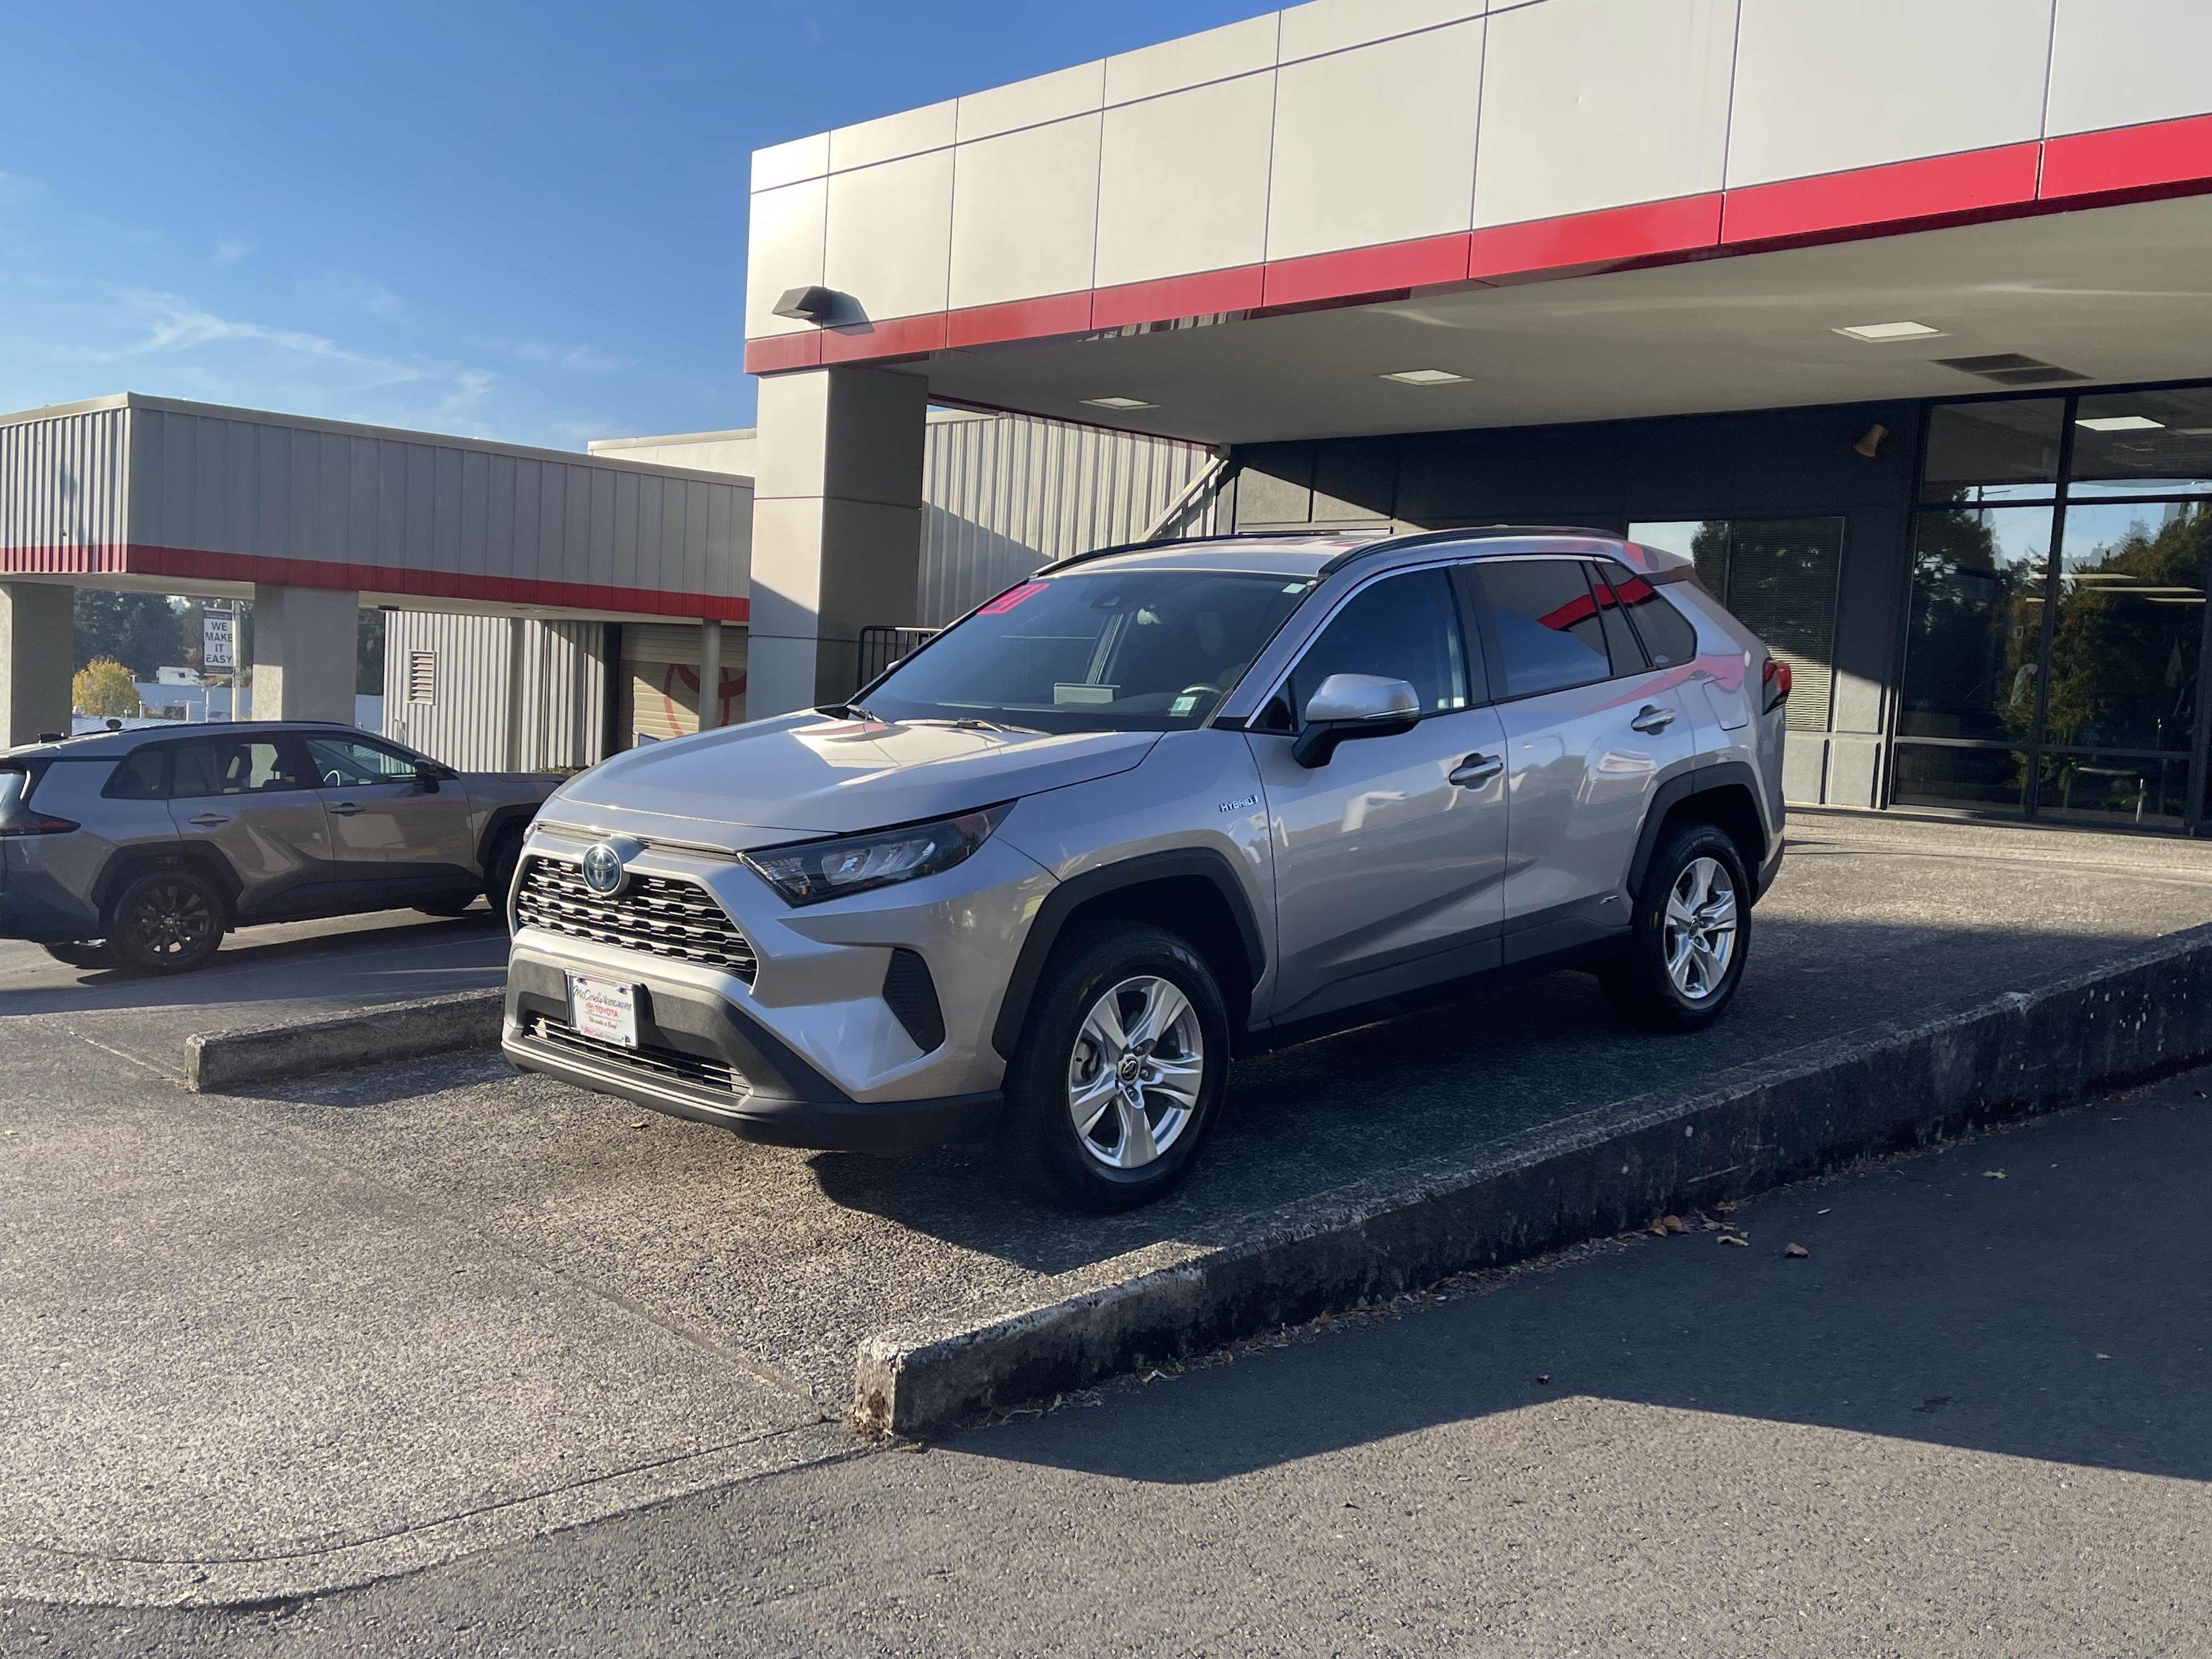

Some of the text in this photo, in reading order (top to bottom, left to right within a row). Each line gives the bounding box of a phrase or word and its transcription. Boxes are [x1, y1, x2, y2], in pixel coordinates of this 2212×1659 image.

[211, 621, 228, 631] WE
[205, 632, 233, 642] MAKE
[215, 644, 224, 652] IT
[206, 654, 233, 664] EASY
[1220, 797, 1255, 812] HYBRID
[595, 1005, 619, 1018] TOYOTA
